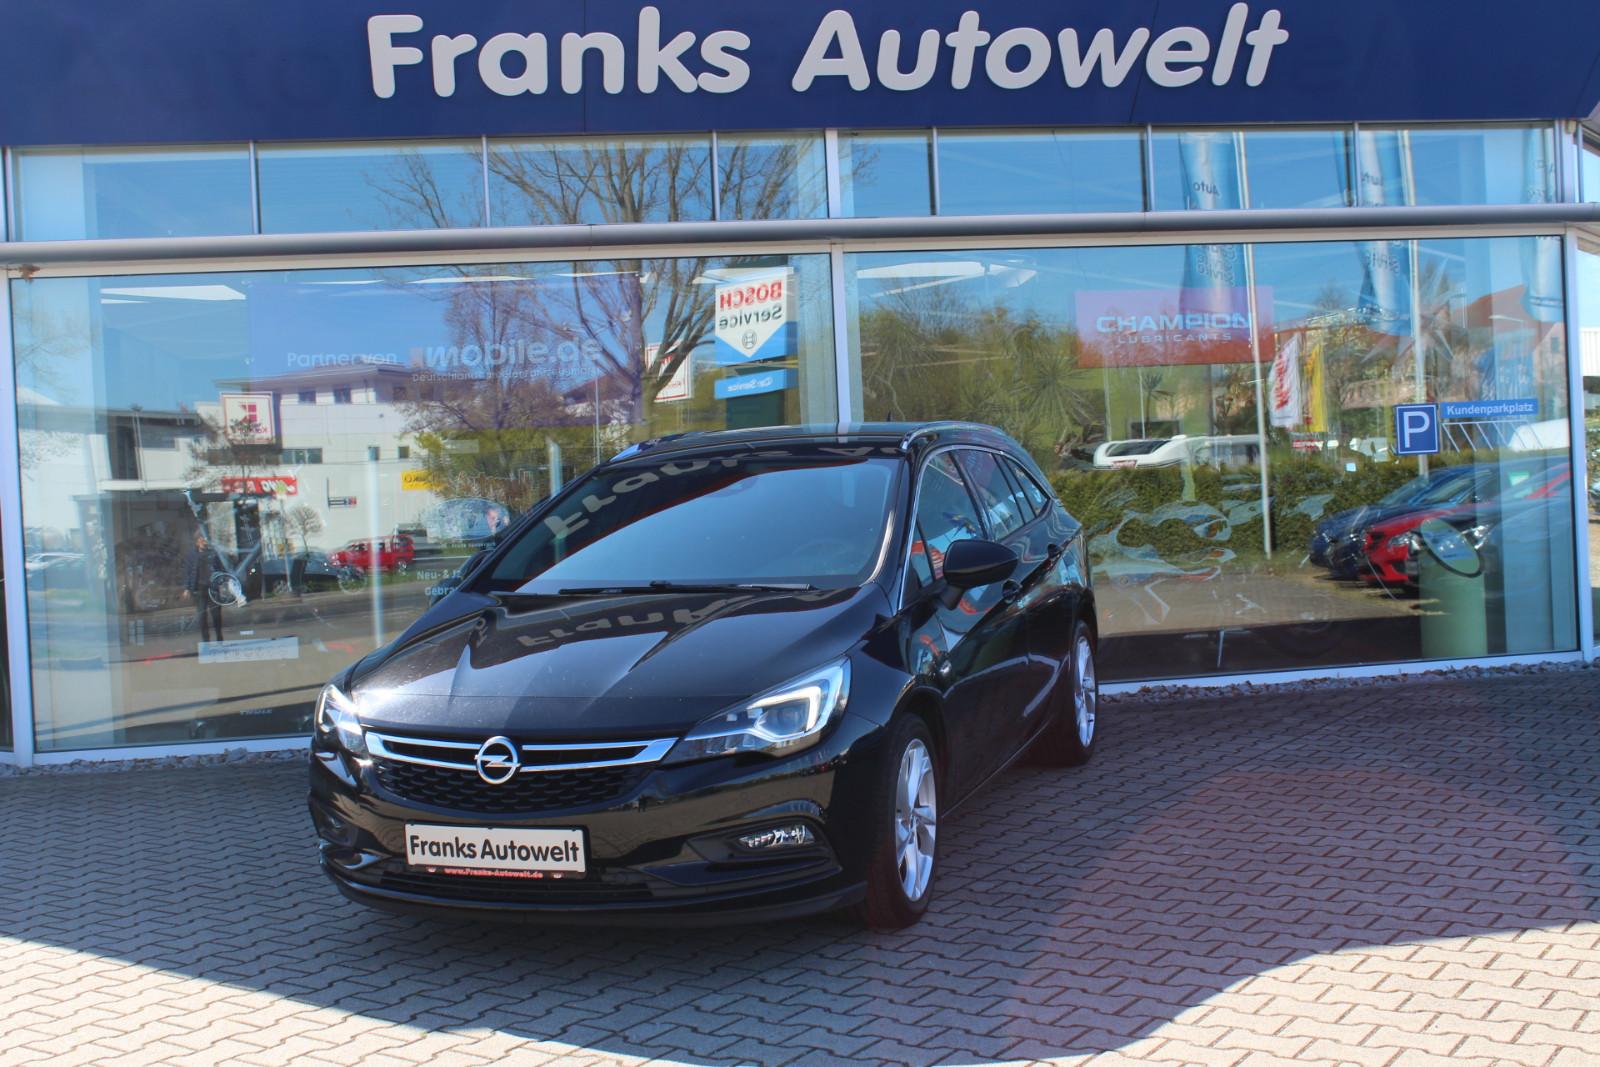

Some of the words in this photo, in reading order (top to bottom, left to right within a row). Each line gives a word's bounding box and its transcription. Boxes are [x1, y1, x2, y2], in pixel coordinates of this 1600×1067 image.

[367, 5, 751, 98] Franks
[791, 2, 1289, 92] Autowelt
[1096, 312, 1251, 333] CHAMPION
[1117, 332, 1232, 344] LUBRICANTS
[287, 352, 359, 368] Partner
[361, 353, 397, 367] von
[425, 336, 600, 368] mobile.de
[1446, 402, 1534, 416] Kundenparkplatz
[1403, 411, 1430, 448] P
[409, 834, 478, 860] Franks
[480, 838, 580, 863] Autowelt
[444, 866, 544, 879] www.Franks-Autowelt.de
